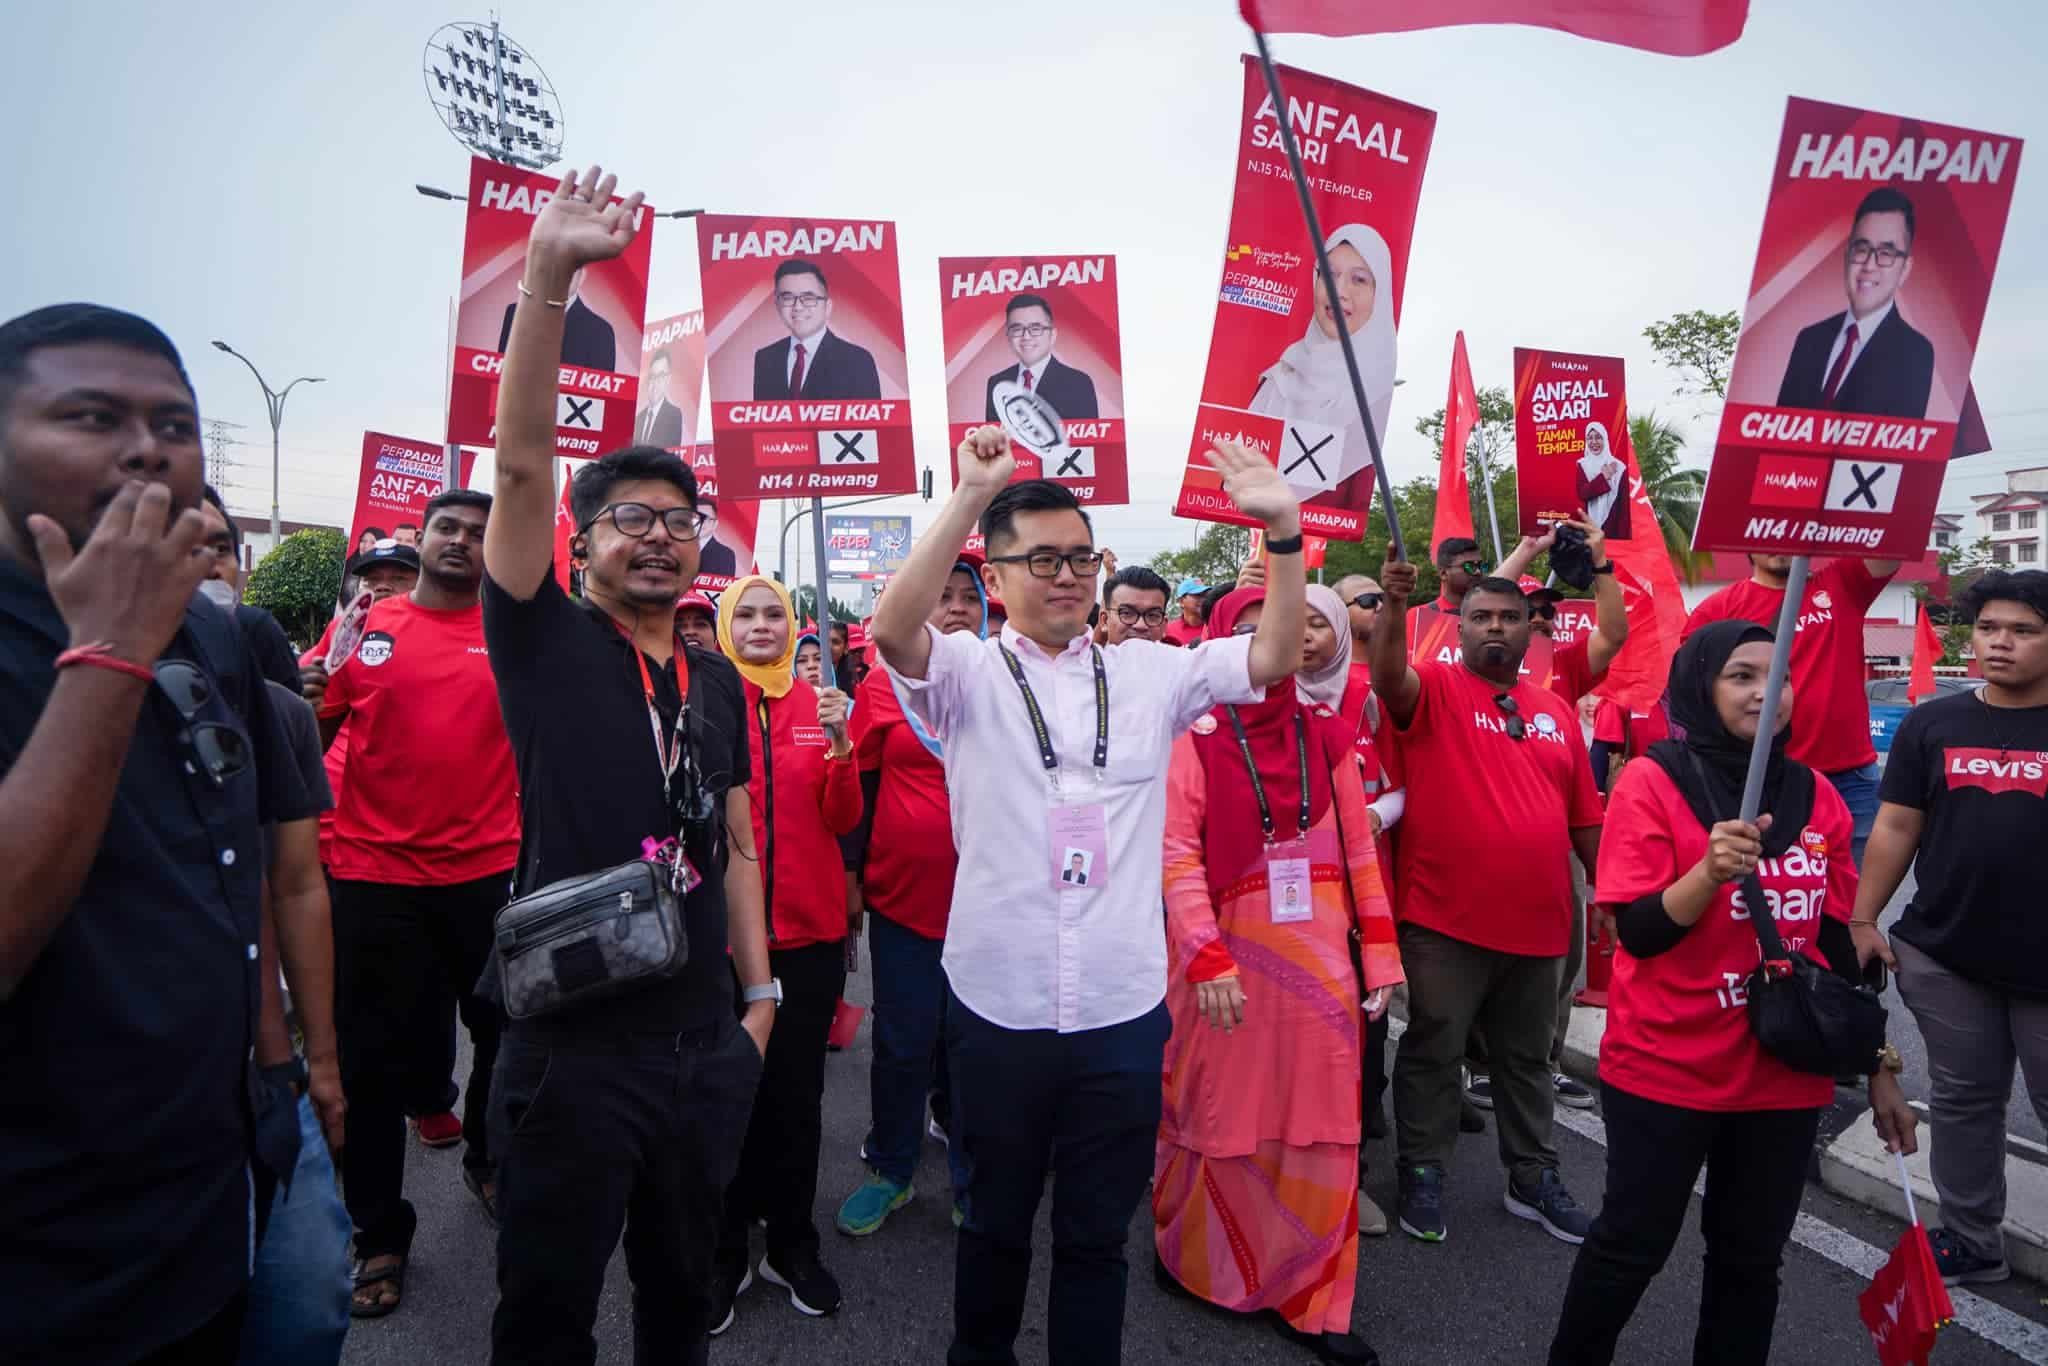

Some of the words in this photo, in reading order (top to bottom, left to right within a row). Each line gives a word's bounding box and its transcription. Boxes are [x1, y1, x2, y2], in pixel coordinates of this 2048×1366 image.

[1253, 91, 1409, 164] ANFAAL
[1789, 133, 2010, 183] HARAPAN
[1319, 178, 1373, 203] TEMPLER
[711, 224, 884, 261] HARAPAN
[952, 259, 1105, 299] HARAPAN
[1223, 271, 1298, 298] PERPADUAN
[642, 312, 704, 353] ARAPAN
[1551, 361, 1589, 371] HARAPAN
[557, 368, 576, 386] EI
[579, 372, 625, 394] KIAT
[1531, 379, 1608, 402] ANFAAL
[729, 405, 793, 424] CHUA
[799, 405, 841, 422] WEI
[844, 404, 895, 421] KIAT
[1532, 399, 1591, 423] SAARI
[1066, 422, 1112, 439] KIAT
[1536, 427, 1576, 443] TAMAN
[1740, 412, 1815, 444] CHUA
[1820, 418, 1874, 448] WEI
[1871, 423, 1937, 452] KIAT
[379, 443, 441, 465] PERPADU
[556, 435, 600, 453] wang
[762, 441, 809, 455] HARAPAN
[1536, 439, 1585, 455] TEMPLER
[371, 473, 442, 498] ANFAA
[759, 473, 793, 489] N14
[807, 472, 879, 488] Rawang
[1764, 471, 1818, 490] HARAPAN
[369, 487, 410, 504] SAARI
[1187, 492, 1238, 513] UNDILA
[1302, 511, 1358, 529] HARAPAN
[1744, 517, 1788, 540] N14
[1800, 520, 1885, 548] Rawang
